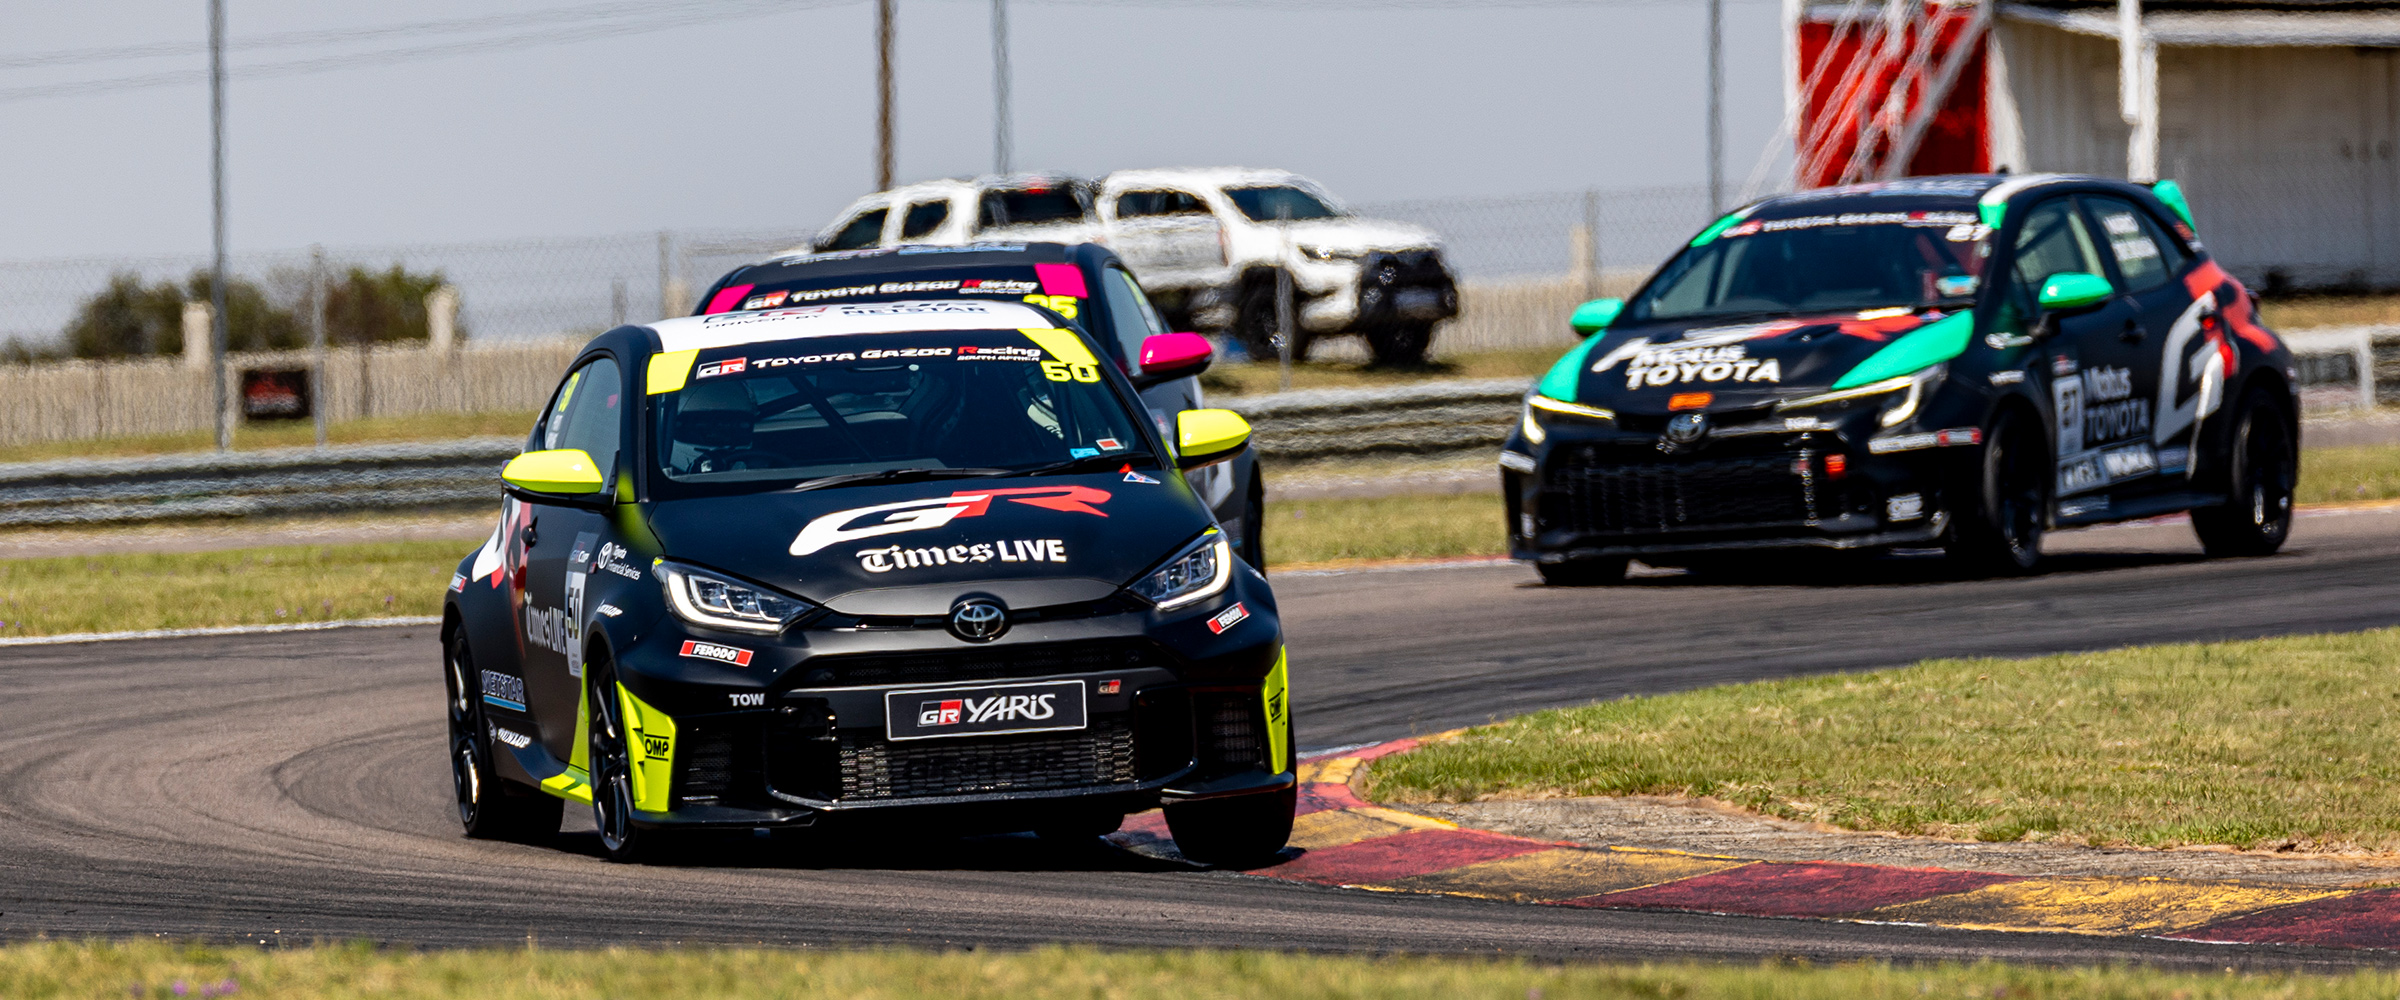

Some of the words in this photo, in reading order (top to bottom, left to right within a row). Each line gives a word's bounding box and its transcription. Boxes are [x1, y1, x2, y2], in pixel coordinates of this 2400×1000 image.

[790, 285, 876, 302] TOYOTA
[879, 280, 960, 293] GAZOO
[698, 360, 746, 378] GR
[752, 353, 857, 369] TOYOTA
[861, 348, 952, 359] GAZOO
[957, 346, 1041, 357] Racing
[1041, 361, 1100, 383] 50
[1625, 358, 1782, 390] TOYOTA
[789, 485, 1112, 556] GR
[855, 541, 994, 574] Times
[999, 539, 1067, 563] LIVE
[694, 644, 736, 661] FERODO
[481, 669, 525, 703] NETSTAR
[729, 693, 765, 706] TOW
[920, 707, 961, 726] GR
[497, 727, 532, 749] DUNLOP
[645, 738, 669, 757] OMP
